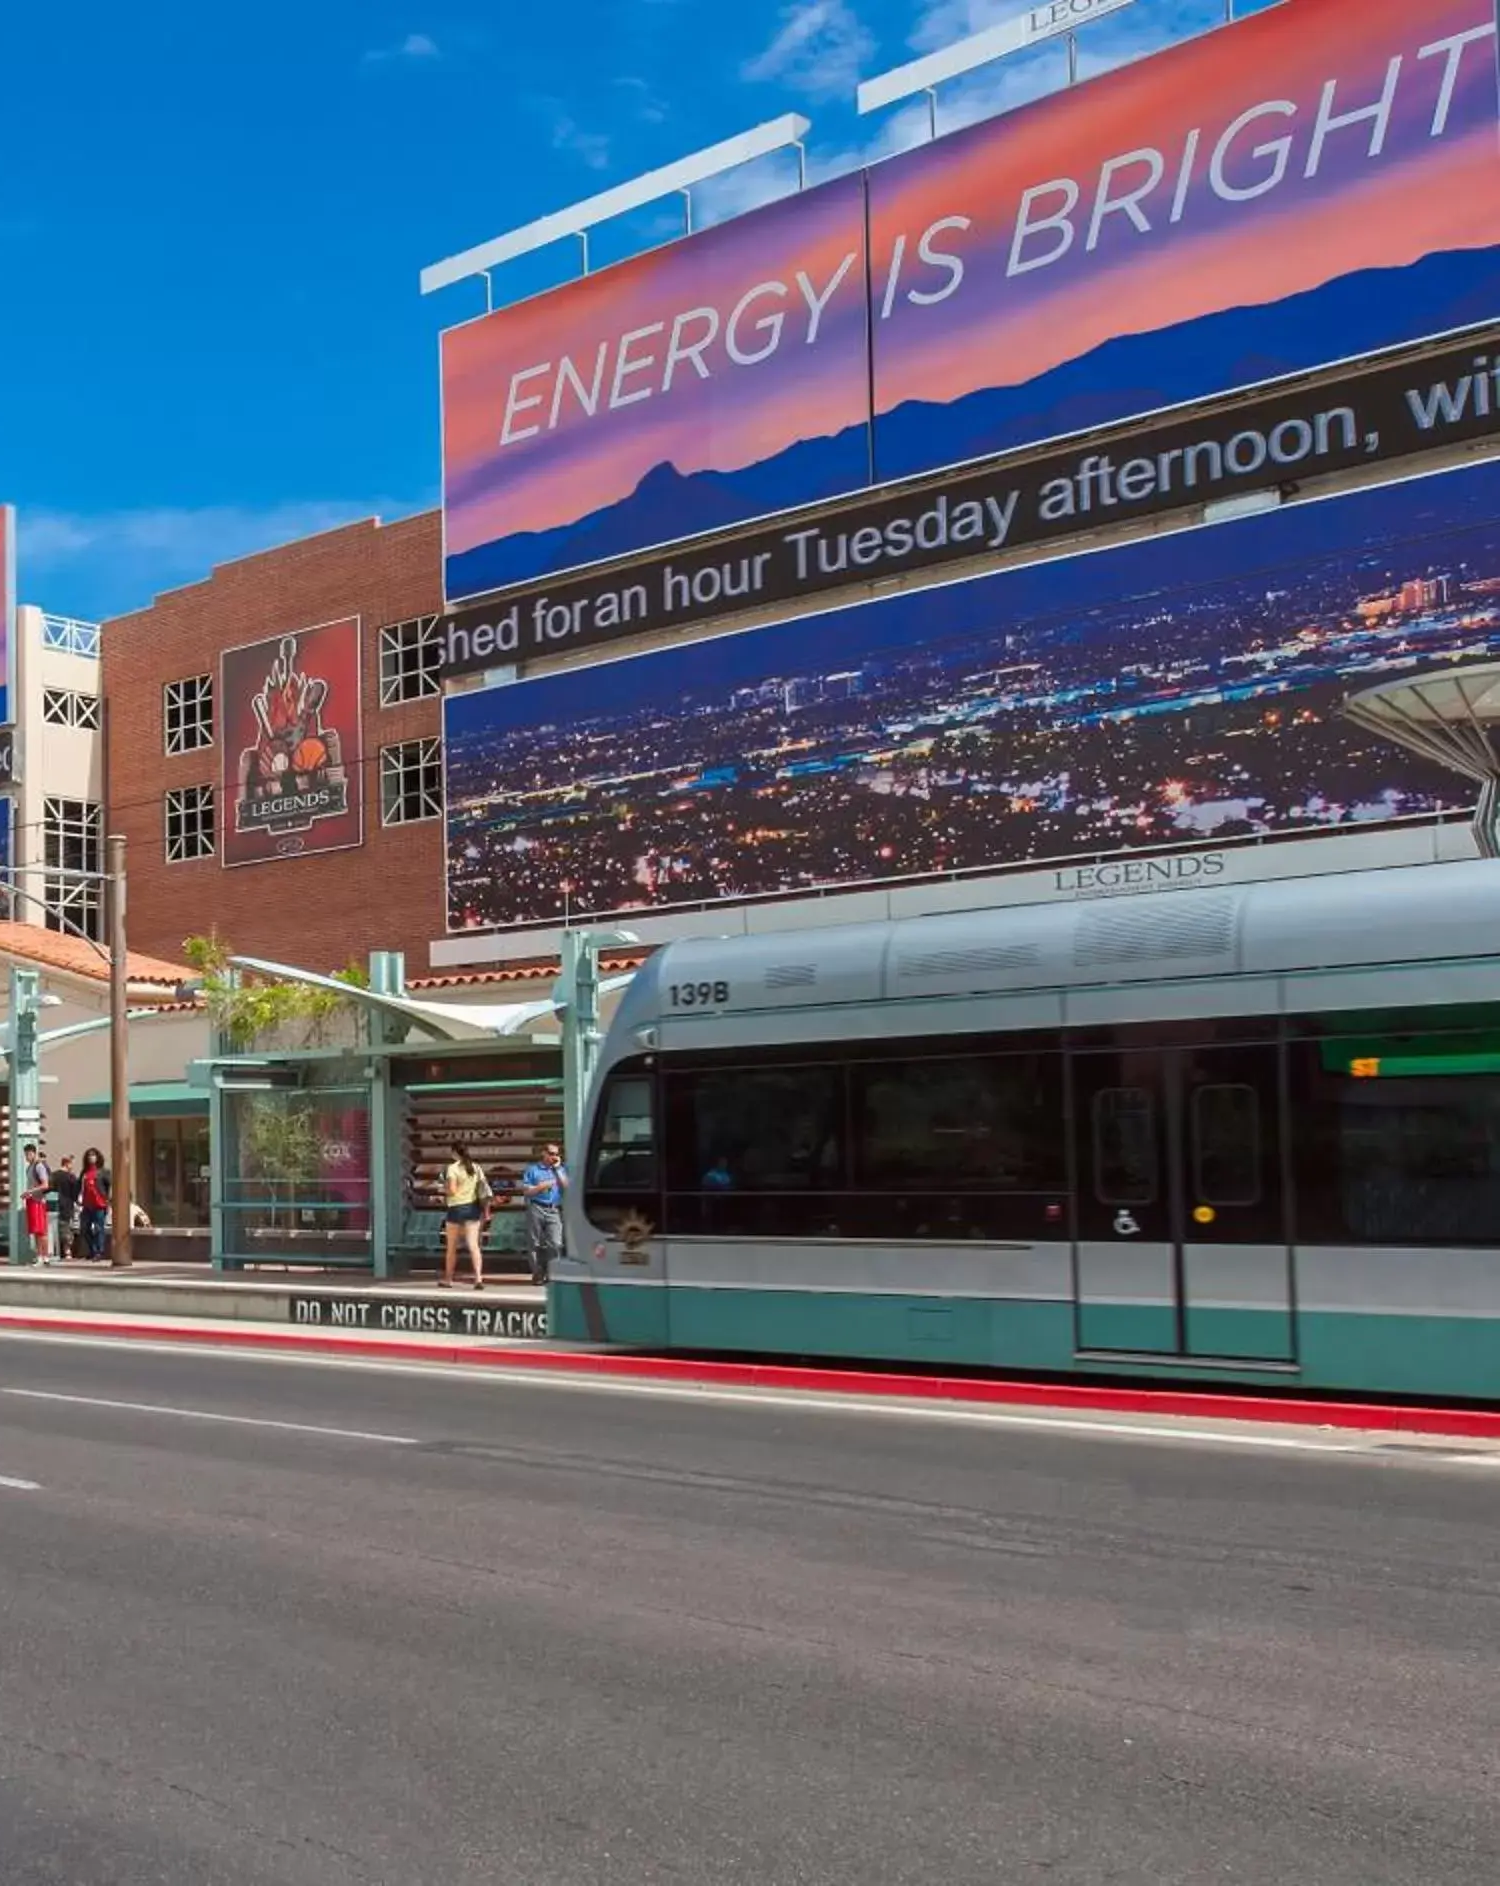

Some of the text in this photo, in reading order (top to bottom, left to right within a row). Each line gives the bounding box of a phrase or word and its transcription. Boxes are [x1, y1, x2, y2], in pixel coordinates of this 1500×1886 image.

[500, 20, 1497, 447] ENERGY IS BRIGHT
[532, 598, 588, 643] for
[594, 584, 647, 628] an
[663, 552, 772, 612] hour
[783, 490, 1021, 579] Tuesday
[1038, 406, 1380, 521] afternoon,
[252, 789, 330, 817] LEGENDS
[1055, 853, 1225, 891] LEGENDS
[668, 981, 729, 1006] 139B
[296, 1300, 549, 1337] DO NOT CROSS TRACKS
